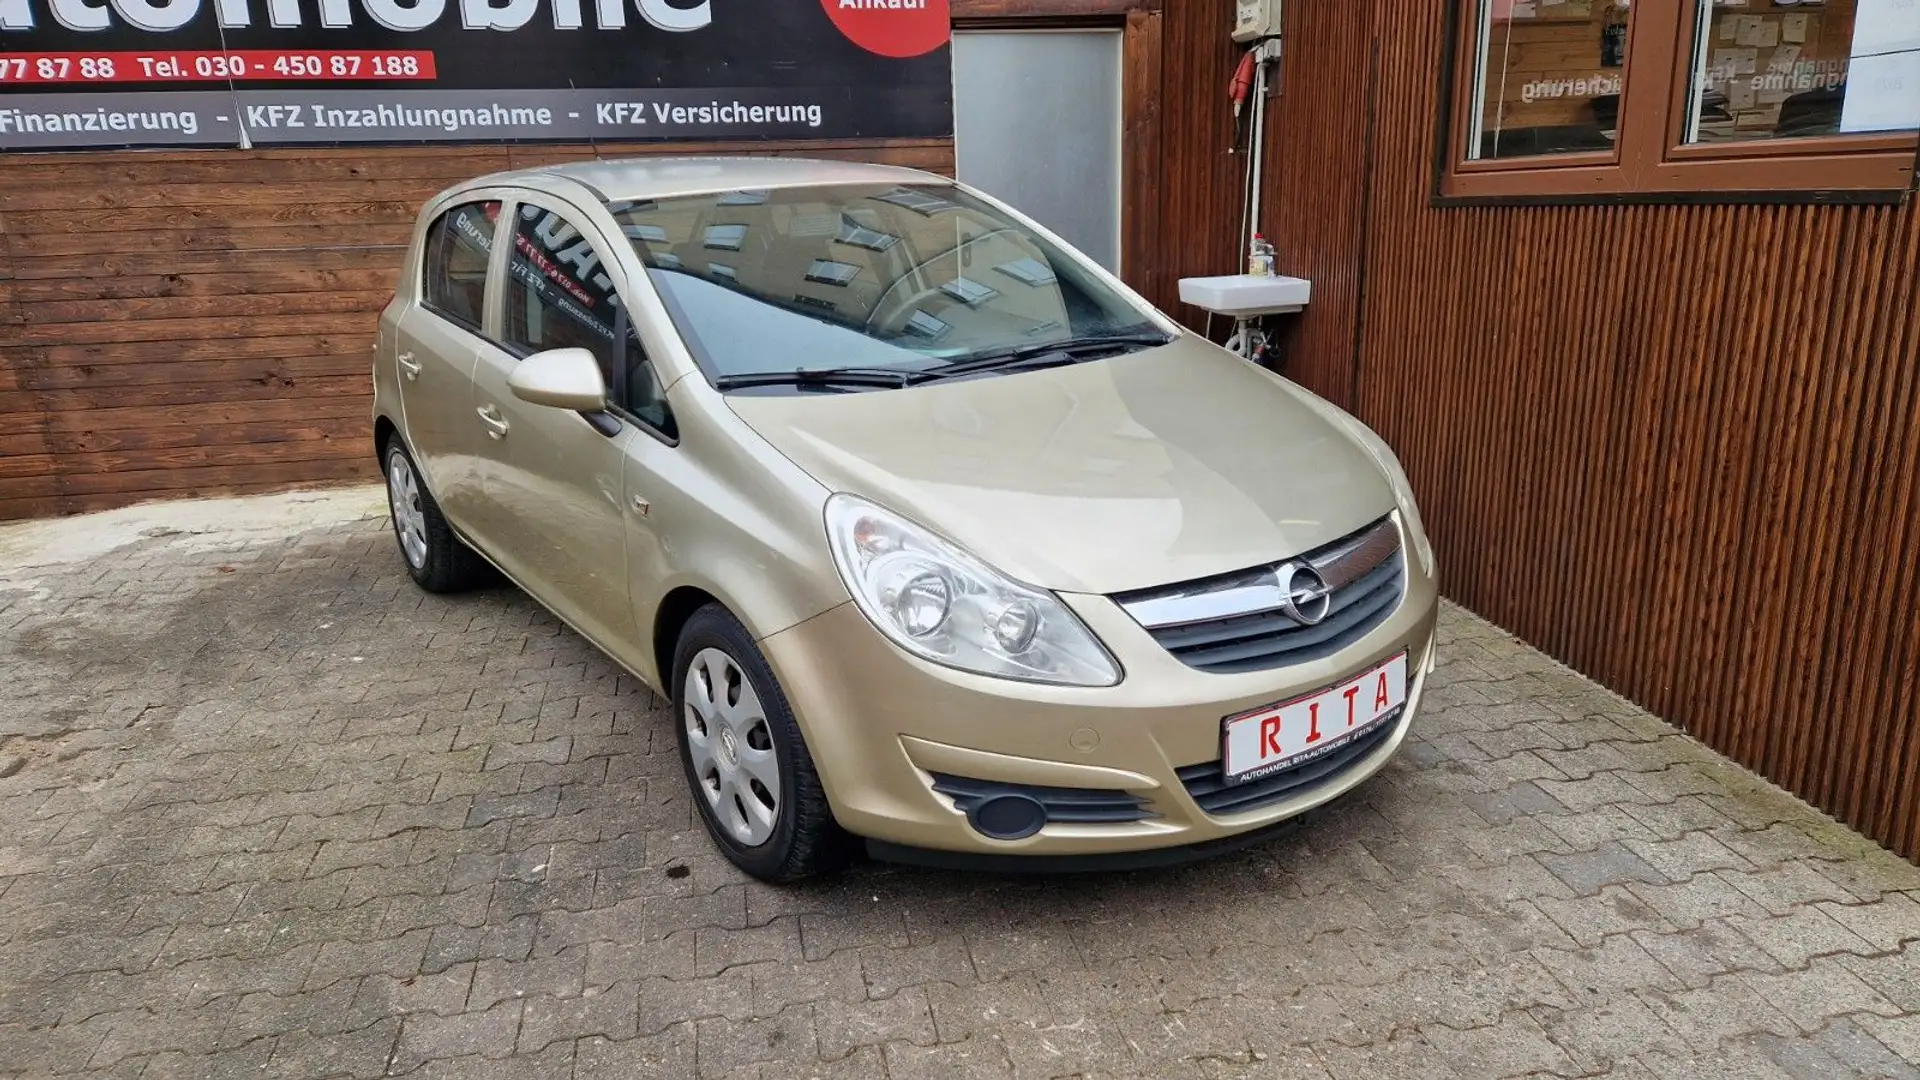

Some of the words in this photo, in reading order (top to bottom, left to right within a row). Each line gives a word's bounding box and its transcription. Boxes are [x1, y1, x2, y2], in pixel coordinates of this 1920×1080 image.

[36, 57, 70, 79] 87
[80, 57, 115, 78] 88
[137, 56, 188, 78] Tel.
[195, 56, 245, 77] 030
[273, 56, 322, 76] 450
[330, 56, 361, 76] 87
[371, 55, 419, 76] 188
[0, 107, 198, 135] Finanzierung
[246, 105, 304, 128] KFZ
[311, 103, 552, 132] Inzahlungnahme
[596, 102, 646, 124] KFZ
[652, 101, 822, 127] Versicherung
[1240, 760, 1293, 783] AUTOHANDEL
